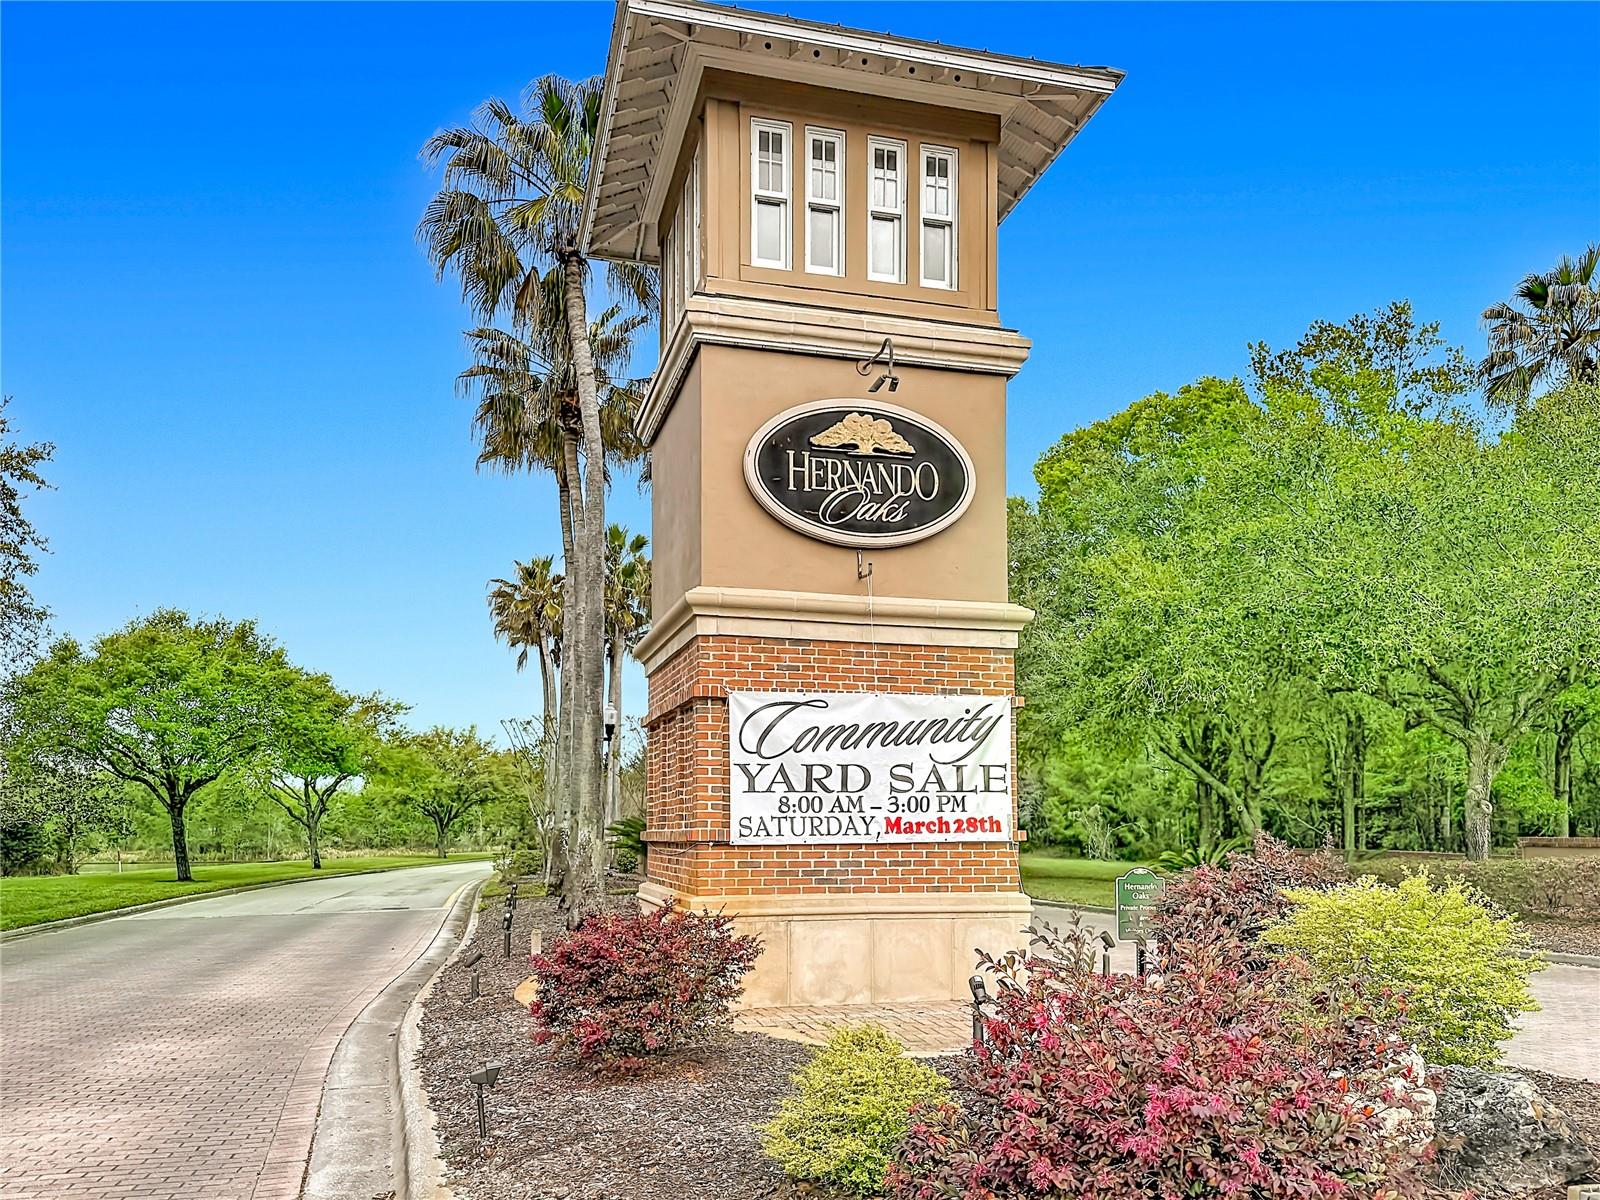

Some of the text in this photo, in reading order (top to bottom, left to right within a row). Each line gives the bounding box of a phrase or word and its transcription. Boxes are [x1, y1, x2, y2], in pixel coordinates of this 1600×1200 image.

[786, 449, 939, 501] HERNANDO
[819, 484, 910, 524] Oaks
[739, 699, 1003, 764] Community
[733, 762, 1008, 795] YARD SALE
[778, 795, 823, 813] 8:00
[828, 796, 864, 813] AM
[887, 795, 930, 813] 3:00
[938, 795, 968, 813] PM
[738, 816, 882, 840] SATURDAY,
[884, 816, 951, 834] March
[953, 816, 1002, 833] 28th
